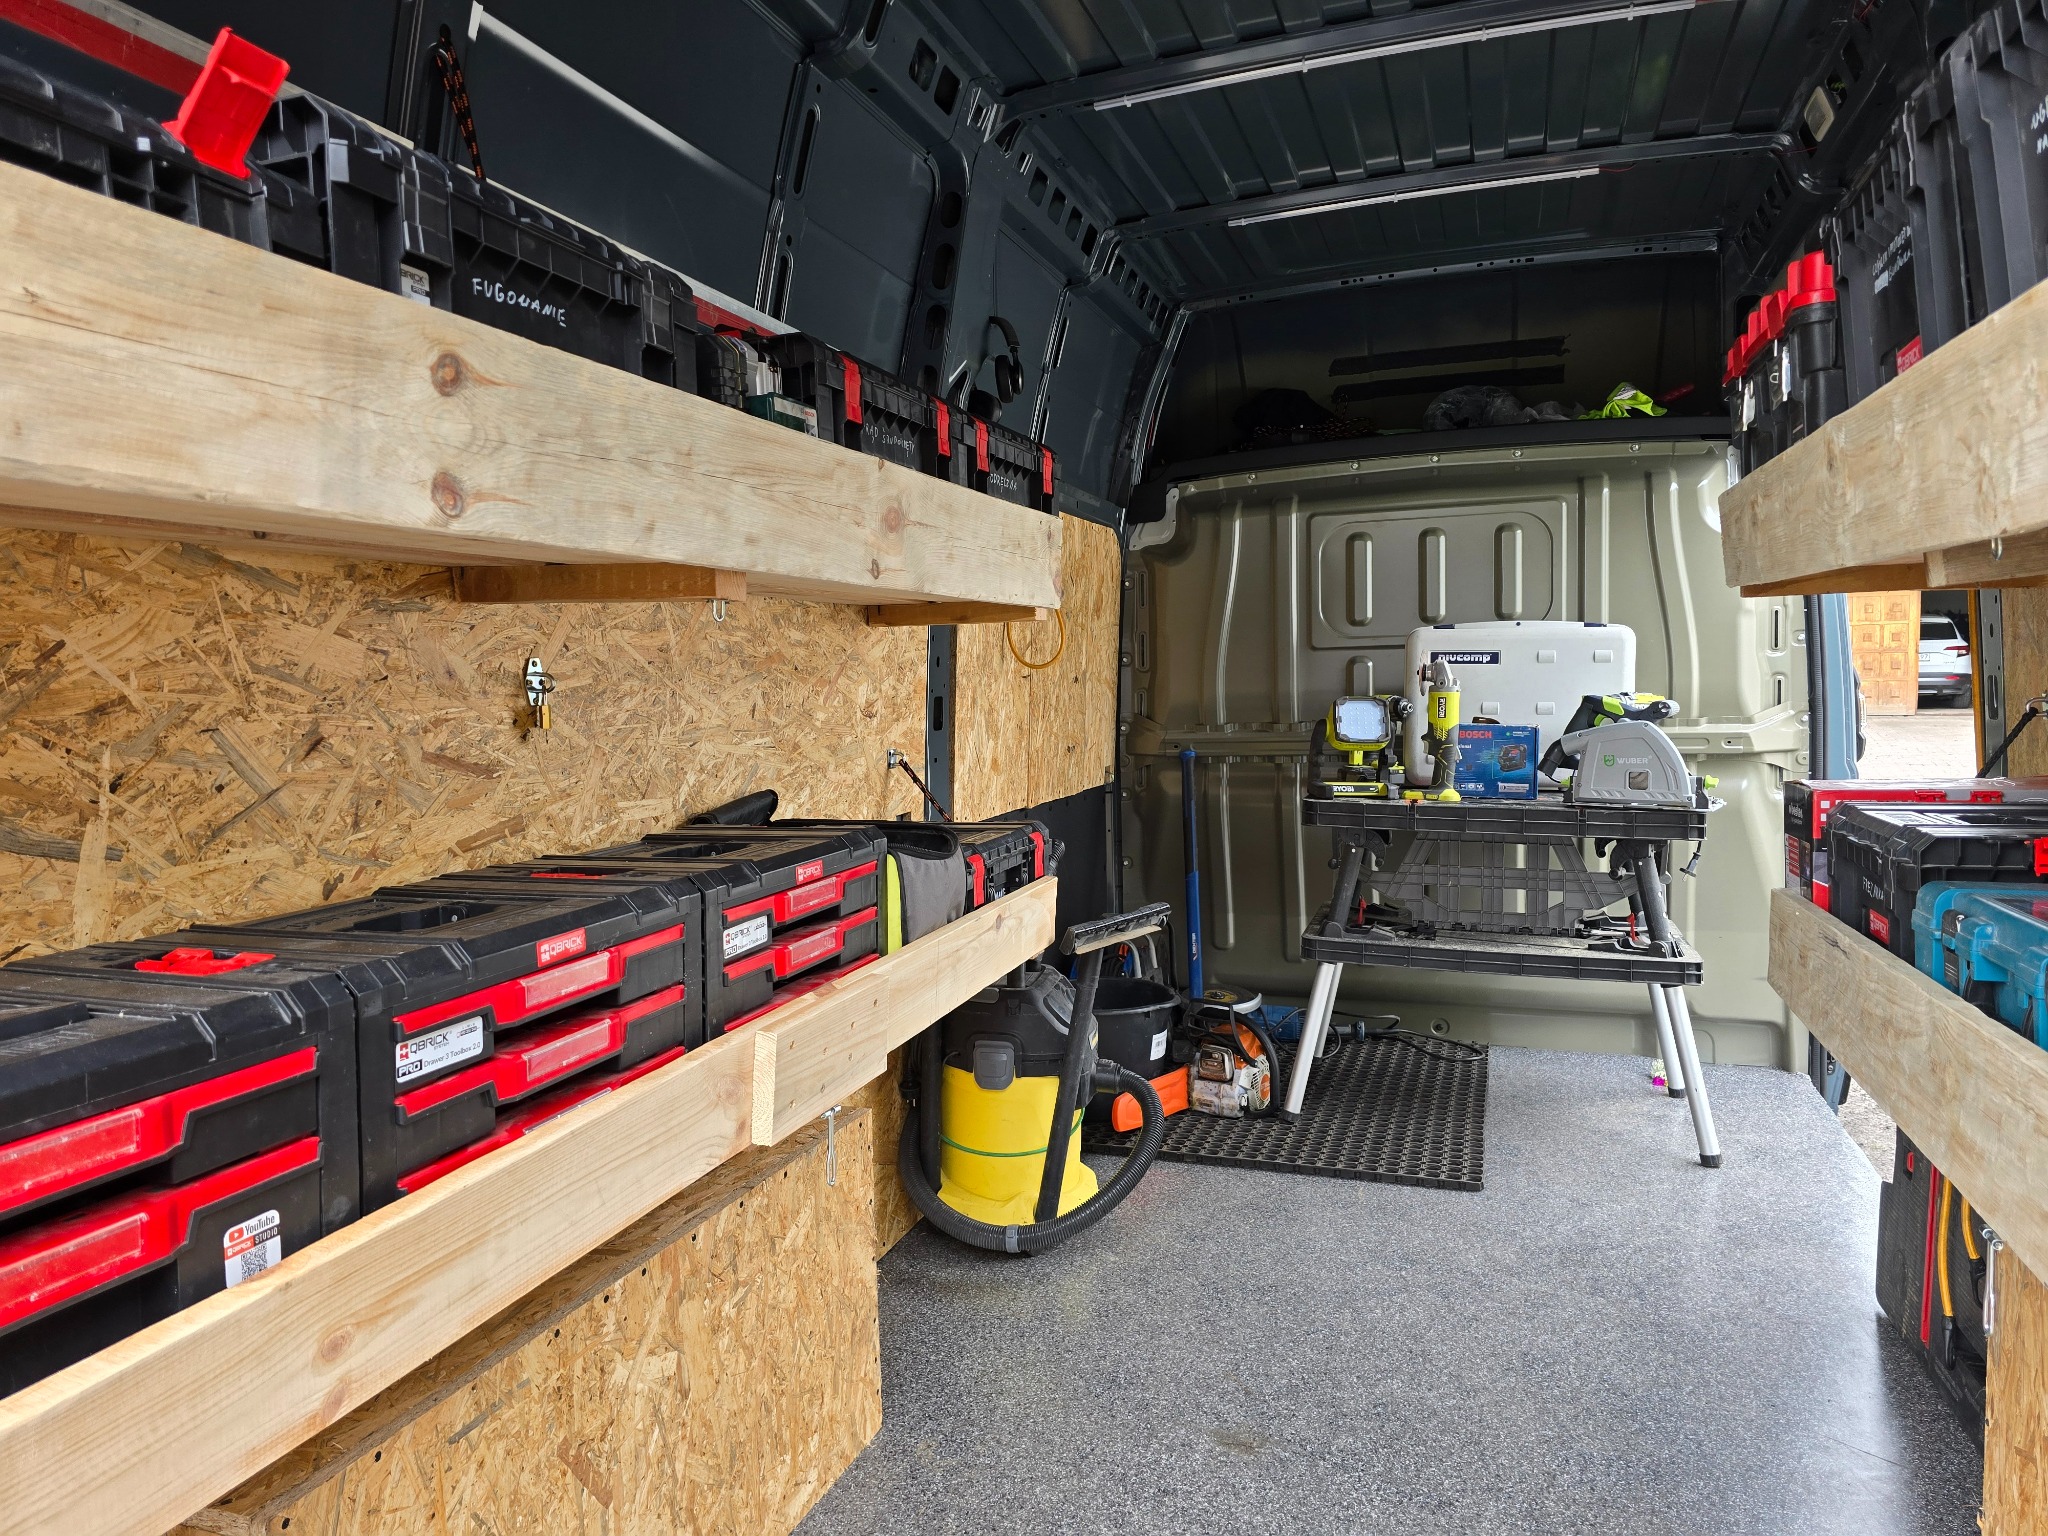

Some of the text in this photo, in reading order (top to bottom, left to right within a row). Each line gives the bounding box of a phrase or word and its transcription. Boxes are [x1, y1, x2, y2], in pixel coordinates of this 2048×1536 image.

[401, 270, 425, 284] BRICK
[1438, 697, 1446, 718] RYOBI
[1459, 730, 1493, 738] BOSCH
[549, 935, 582, 955] QBRICK
[410, 1032, 449, 1054] QBRICK
[398, 1061, 421, 1077] PRO
[424, 1055, 445, 1068] Drawer
[446, 1052, 449, 1060] 3
[450, 1046, 471, 1058] Toolbox
[245, 1215, 275, 1236] YouTube
[255, 1227, 278, 1244] STUDIO
